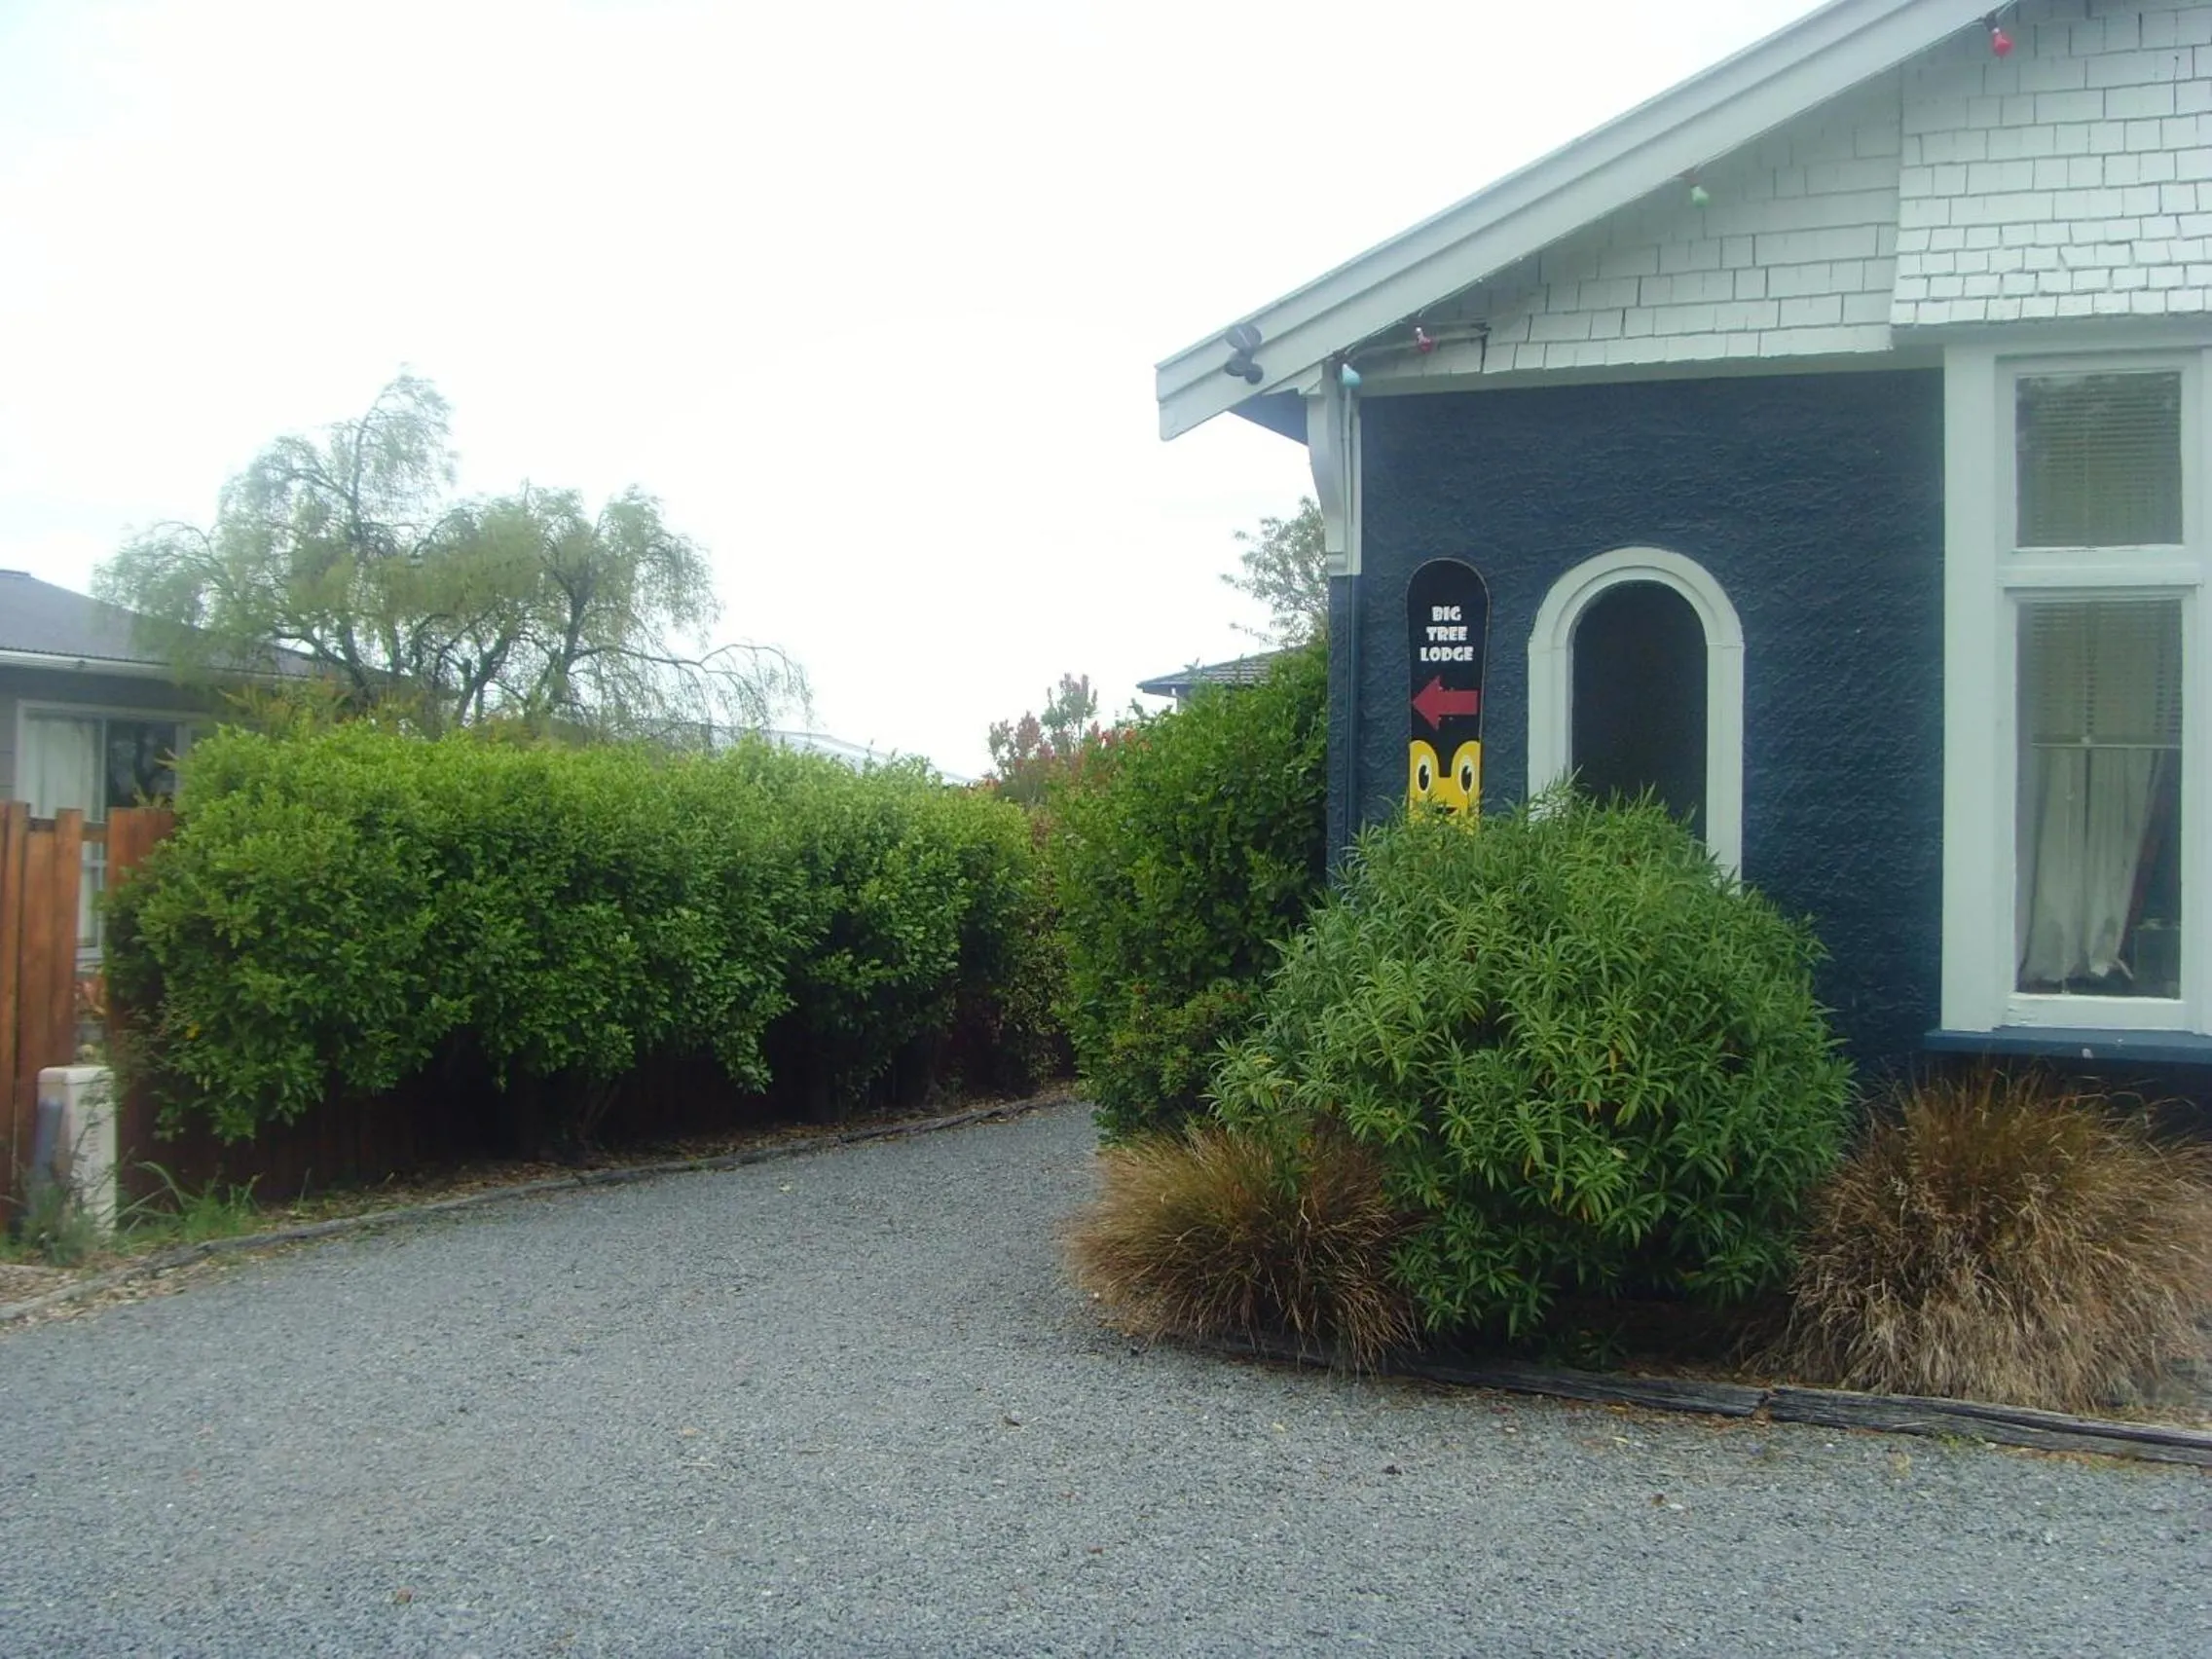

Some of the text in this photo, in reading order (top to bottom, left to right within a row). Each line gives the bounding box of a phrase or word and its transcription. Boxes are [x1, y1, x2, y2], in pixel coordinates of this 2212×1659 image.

[1431, 606, 1462, 622] BIG
[1425, 626, 1468, 642] TREE
[1419, 645, 1474, 662] LODGE
